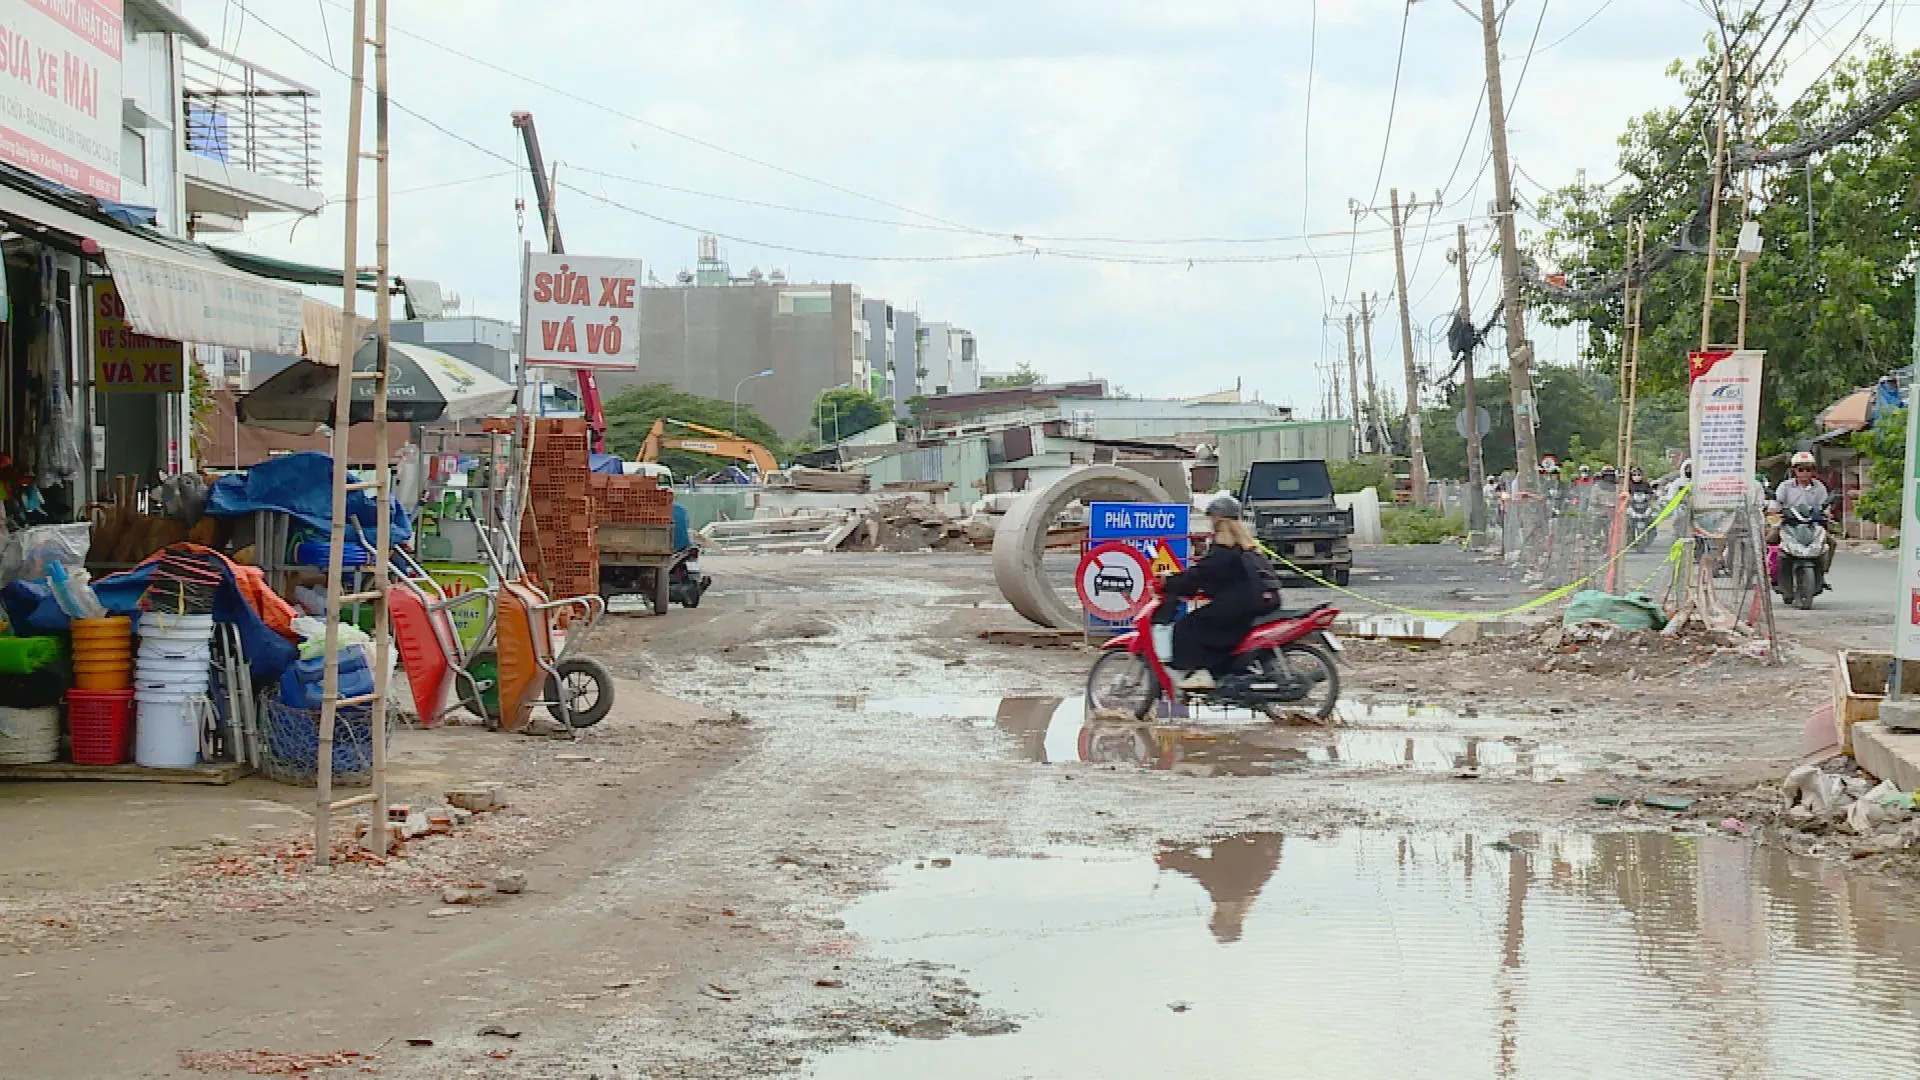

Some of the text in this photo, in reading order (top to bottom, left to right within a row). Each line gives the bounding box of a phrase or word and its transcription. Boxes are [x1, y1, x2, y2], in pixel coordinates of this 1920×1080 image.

[37, 47, 57, 98] XE
[64, 49, 97, 119] MAI
[534, 264, 636, 308] SỬA XE
[542, 315, 622, 355] VÁ VỎ
[143, 363, 173, 383] XE
[360, 384, 417, 397] Leend
[1105, 508, 1175, 529] PHÍA TRƯỚC
